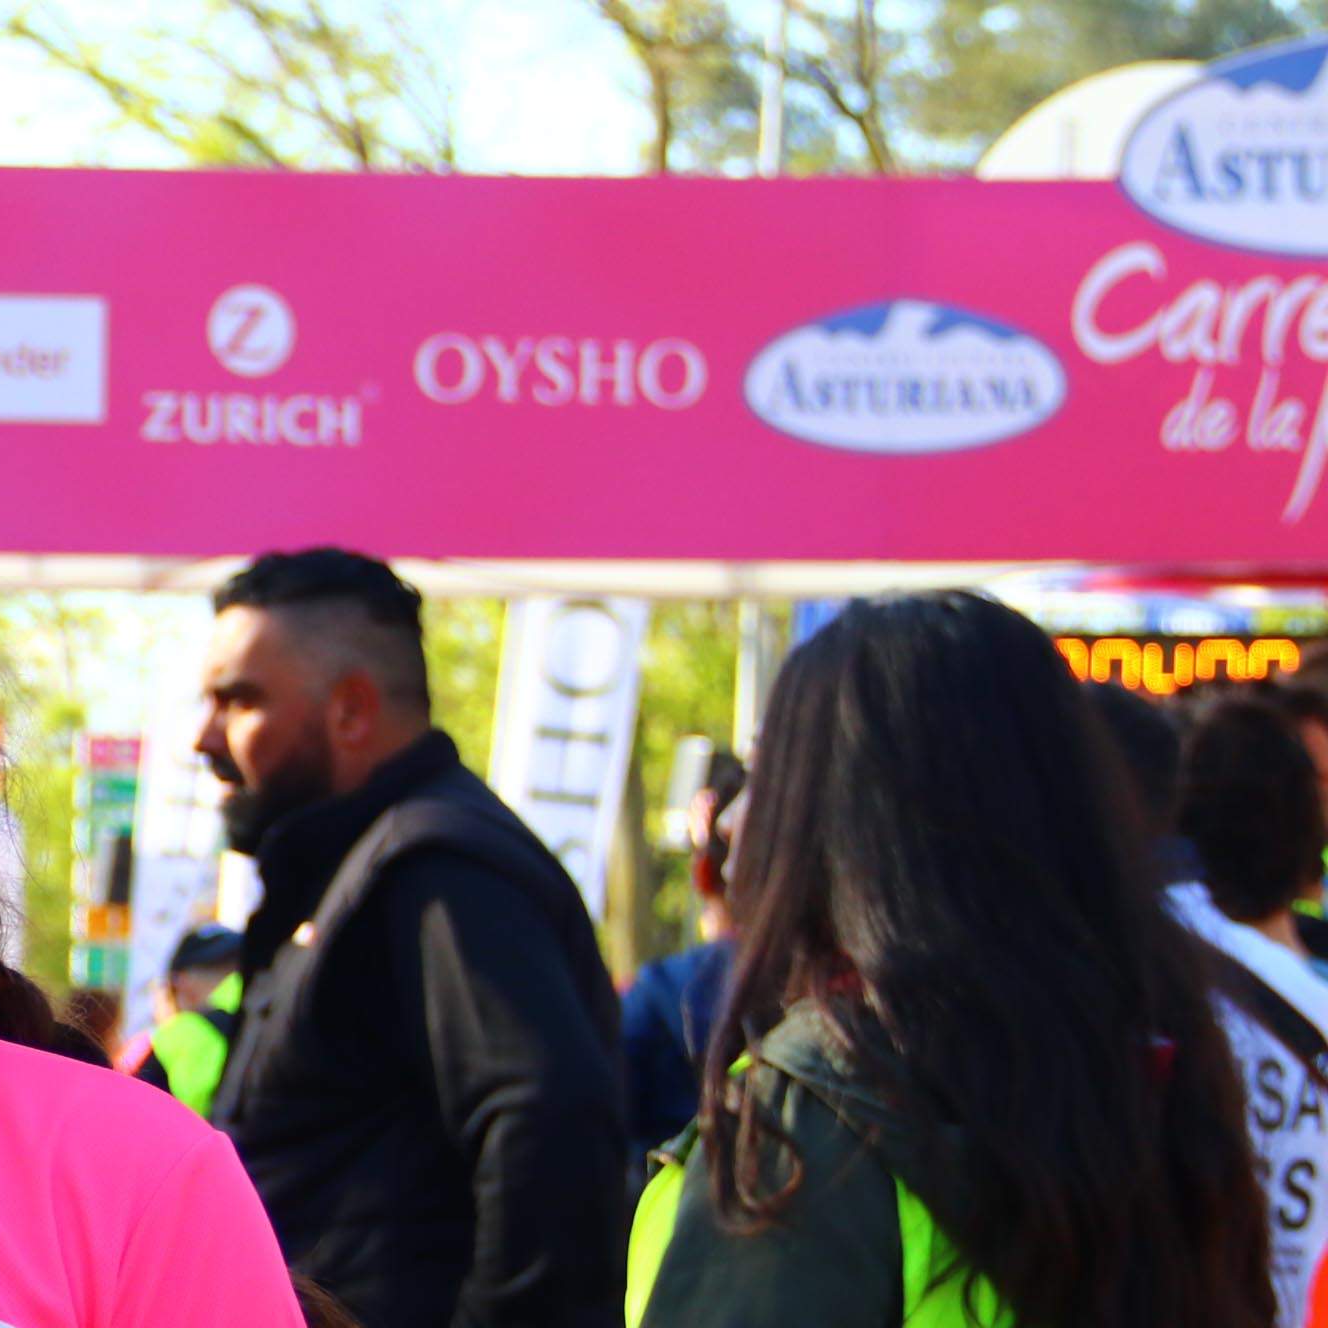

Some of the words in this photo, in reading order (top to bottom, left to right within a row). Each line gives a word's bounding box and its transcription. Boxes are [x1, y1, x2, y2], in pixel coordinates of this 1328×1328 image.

[413, 334, 708, 408] OYSHO
[766, 356, 1042, 416] ASTURIANA
[140, 389, 361, 446] ZURICH
[1159, 366, 1241, 451] de
[1247, 364, 1306, 451] la
